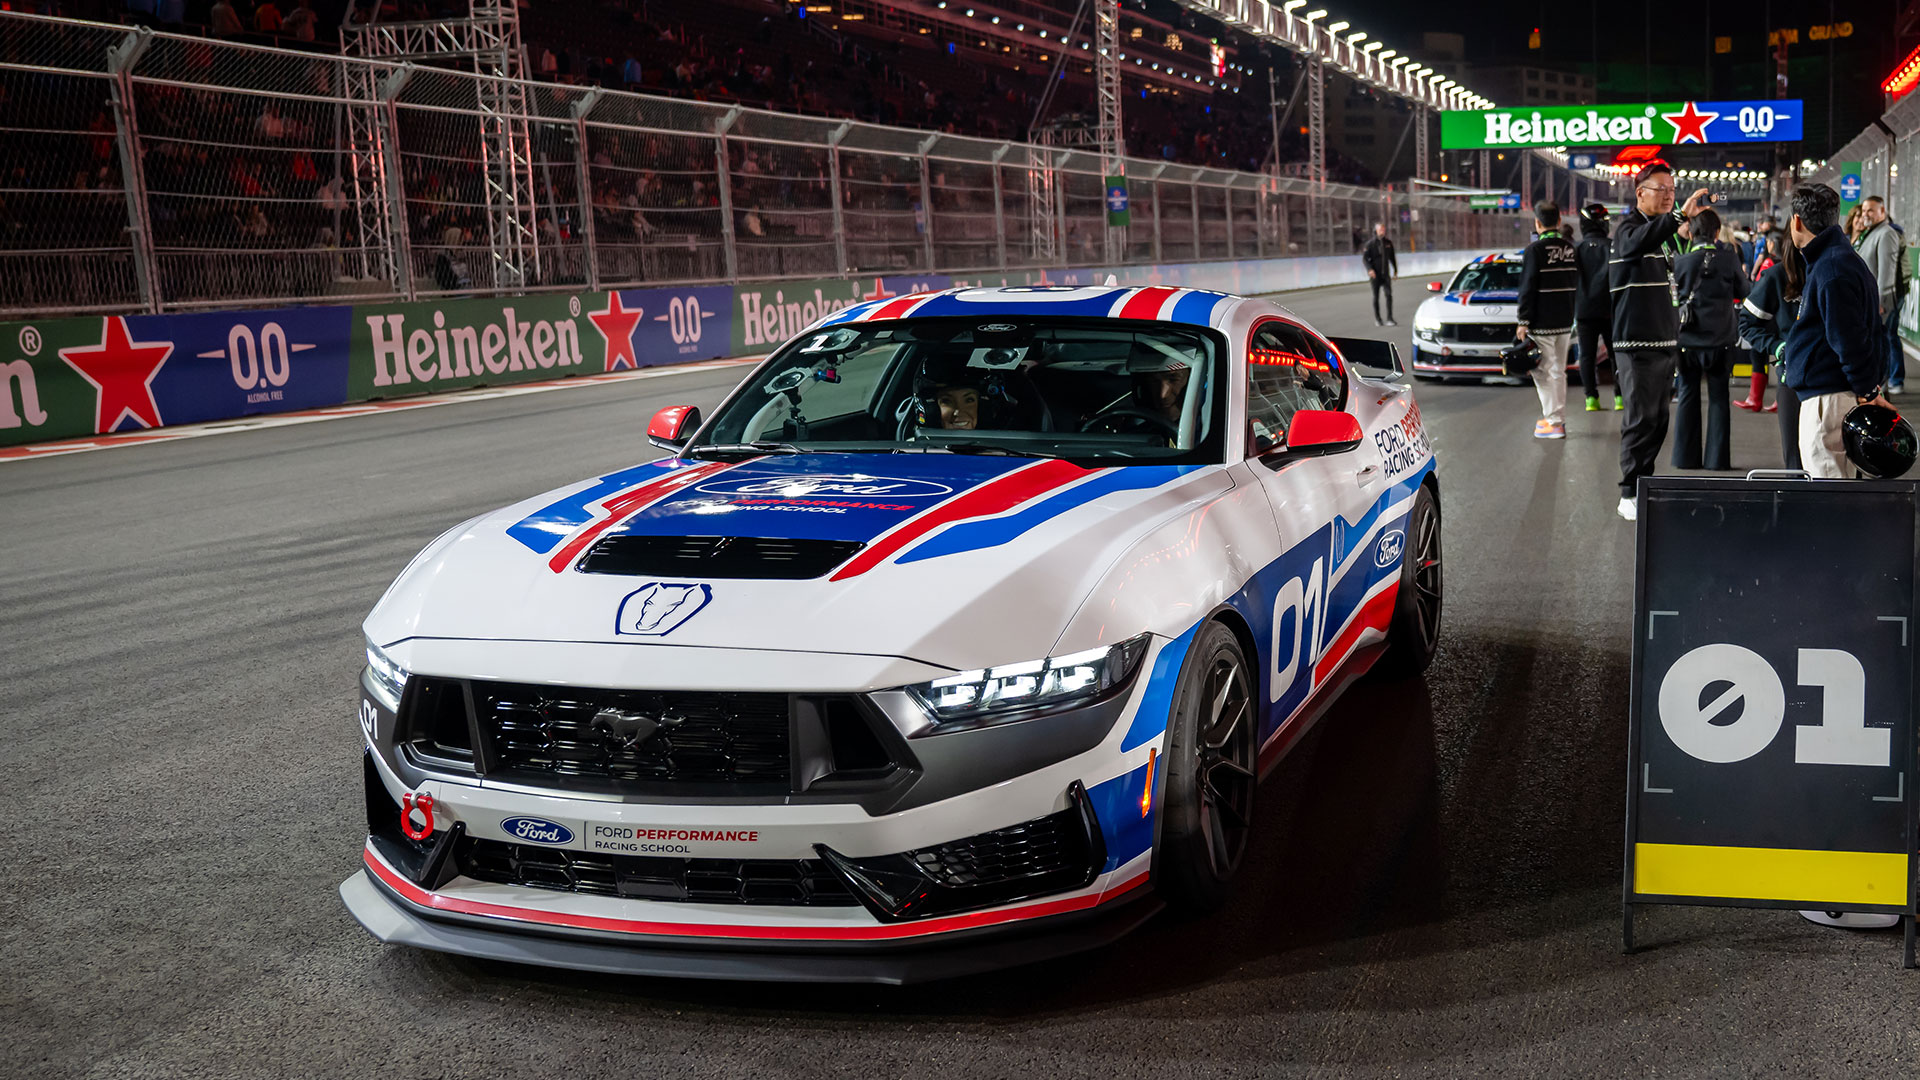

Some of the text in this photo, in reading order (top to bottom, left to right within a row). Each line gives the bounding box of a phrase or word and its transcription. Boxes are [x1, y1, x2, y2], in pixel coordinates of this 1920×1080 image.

[1484, 111, 1654, 144] Heineken
[1739, 106, 1774, 133] 0.0
[669, 296, 702, 345] 0.0
[229, 322, 290, 390] 0.0
[366, 306, 583, 387] Heineken
[1375, 424, 1405, 457] FORD
[1384, 446, 1415, 480] RACING
[728, 499, 915, 511] PERFORMANCE
[769, 505, 847, 514] SCHOOL
[1379, 534, 1401, 564] Ford
[1270, 555, 1324, 704] 01
[363, 698, 379, 740] 01
[1658, 643, 1891, 767] 01
[516, 819, 560, 843] Ford
[594, 826, 759, 842] FORD PERFORMANCE
[594, 841, 691, 853] RACING SCHOOL
